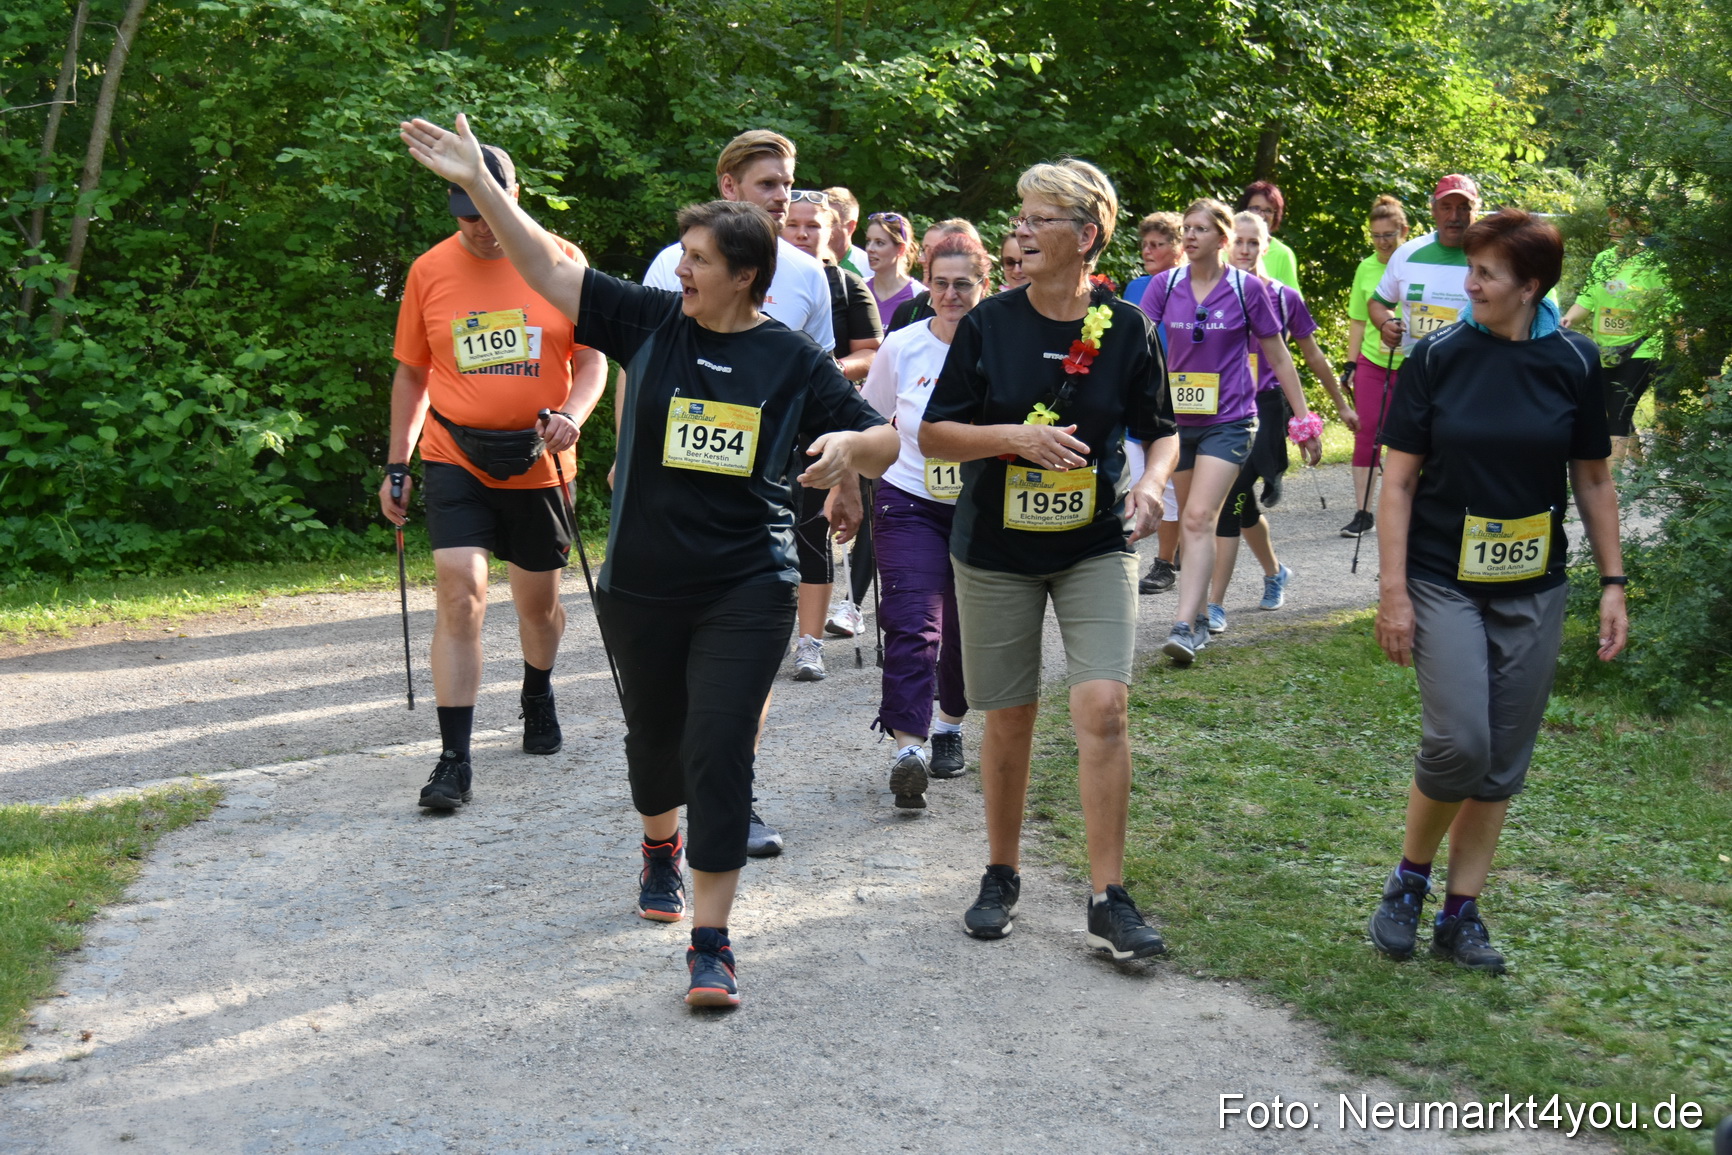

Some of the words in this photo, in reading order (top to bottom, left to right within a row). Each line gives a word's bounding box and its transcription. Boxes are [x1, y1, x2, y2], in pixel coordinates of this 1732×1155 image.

[1185, 322, 1205, 330] SID
[463, 329, 516, 354] 1160
[1177, 388, 1204, 402] 880
[678, 424, 744, 455] 1954
[703, 452, 730, 461] Kerstin
[1017, 491, 1083, 514] 1958
[1474, 538, 1539, 564] 1965
